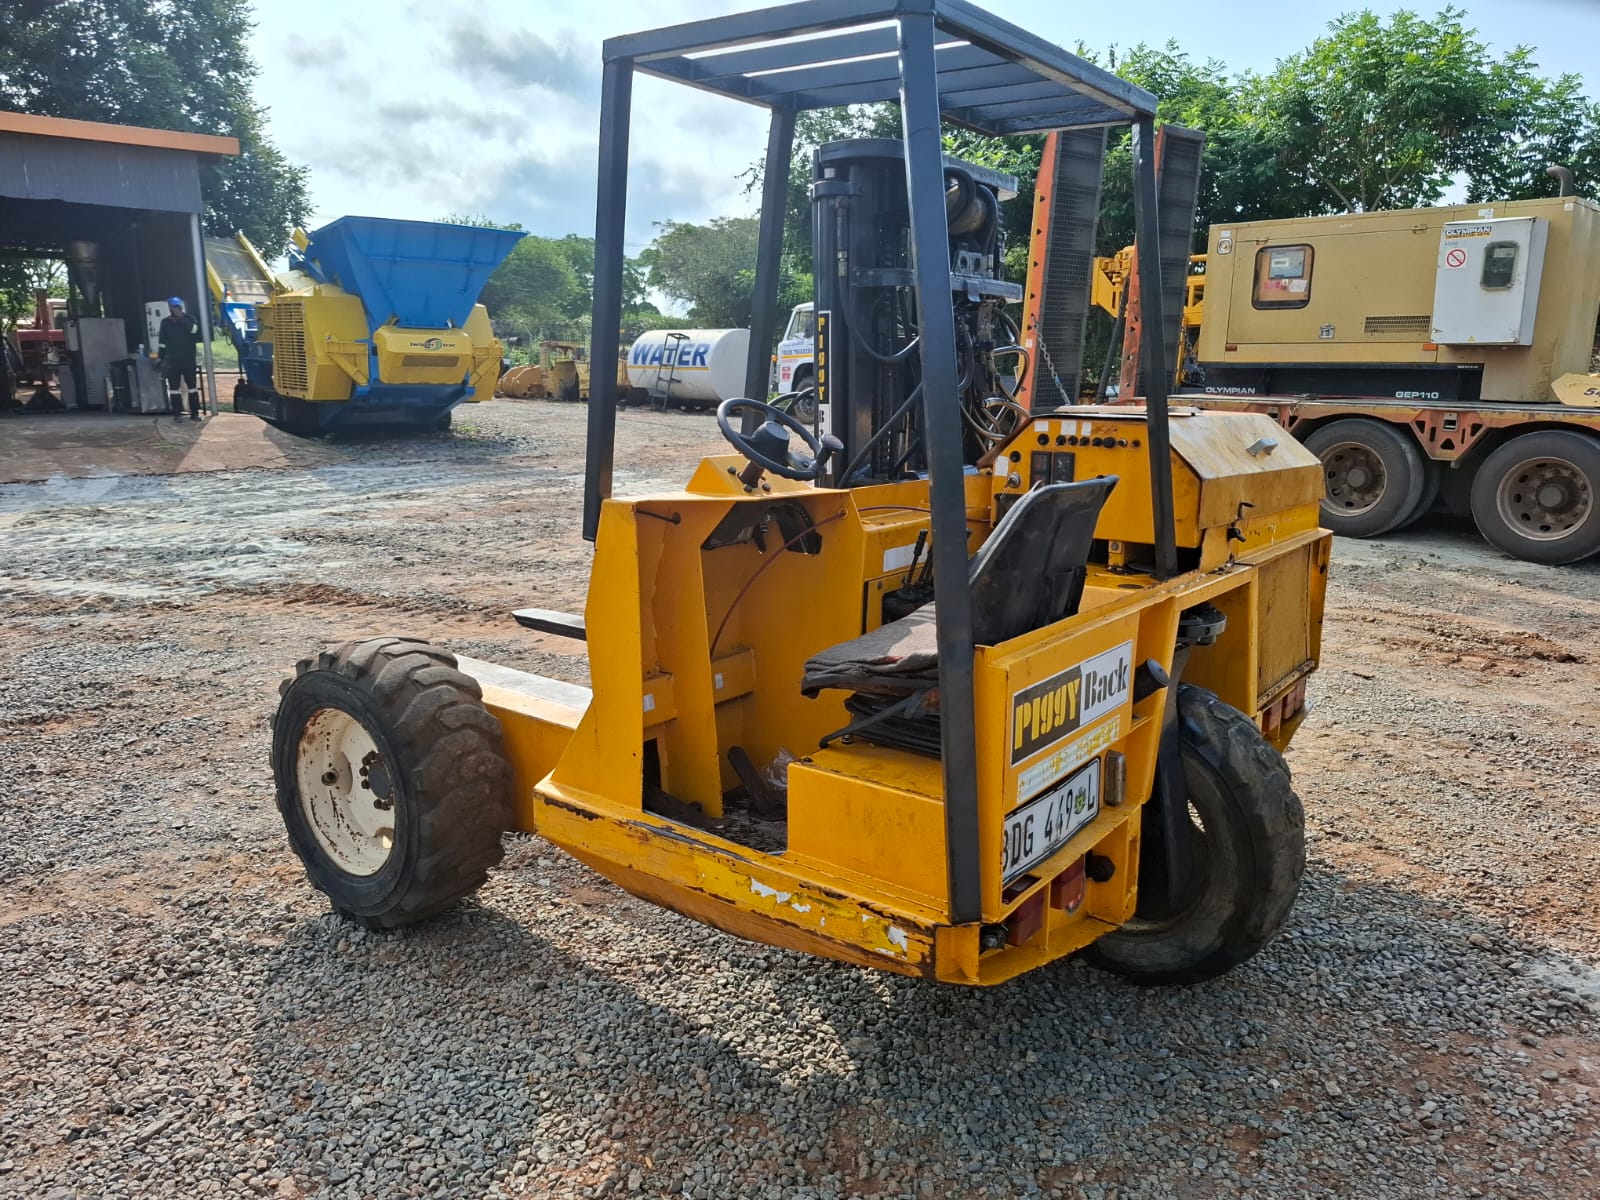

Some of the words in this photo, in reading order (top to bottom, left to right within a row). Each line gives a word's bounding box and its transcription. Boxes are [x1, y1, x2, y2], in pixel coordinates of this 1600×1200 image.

[1445, 226, 1492, 236] OLYMPIAN
[633, 343, 711, 367] WATER
[1205, 386, 1256, 394] OLYMPIAN
[1395, 391, 1439, 399] GEP110
[1084, 657, 1128, 711] Back
[1087, 773, 1095, 812] L
